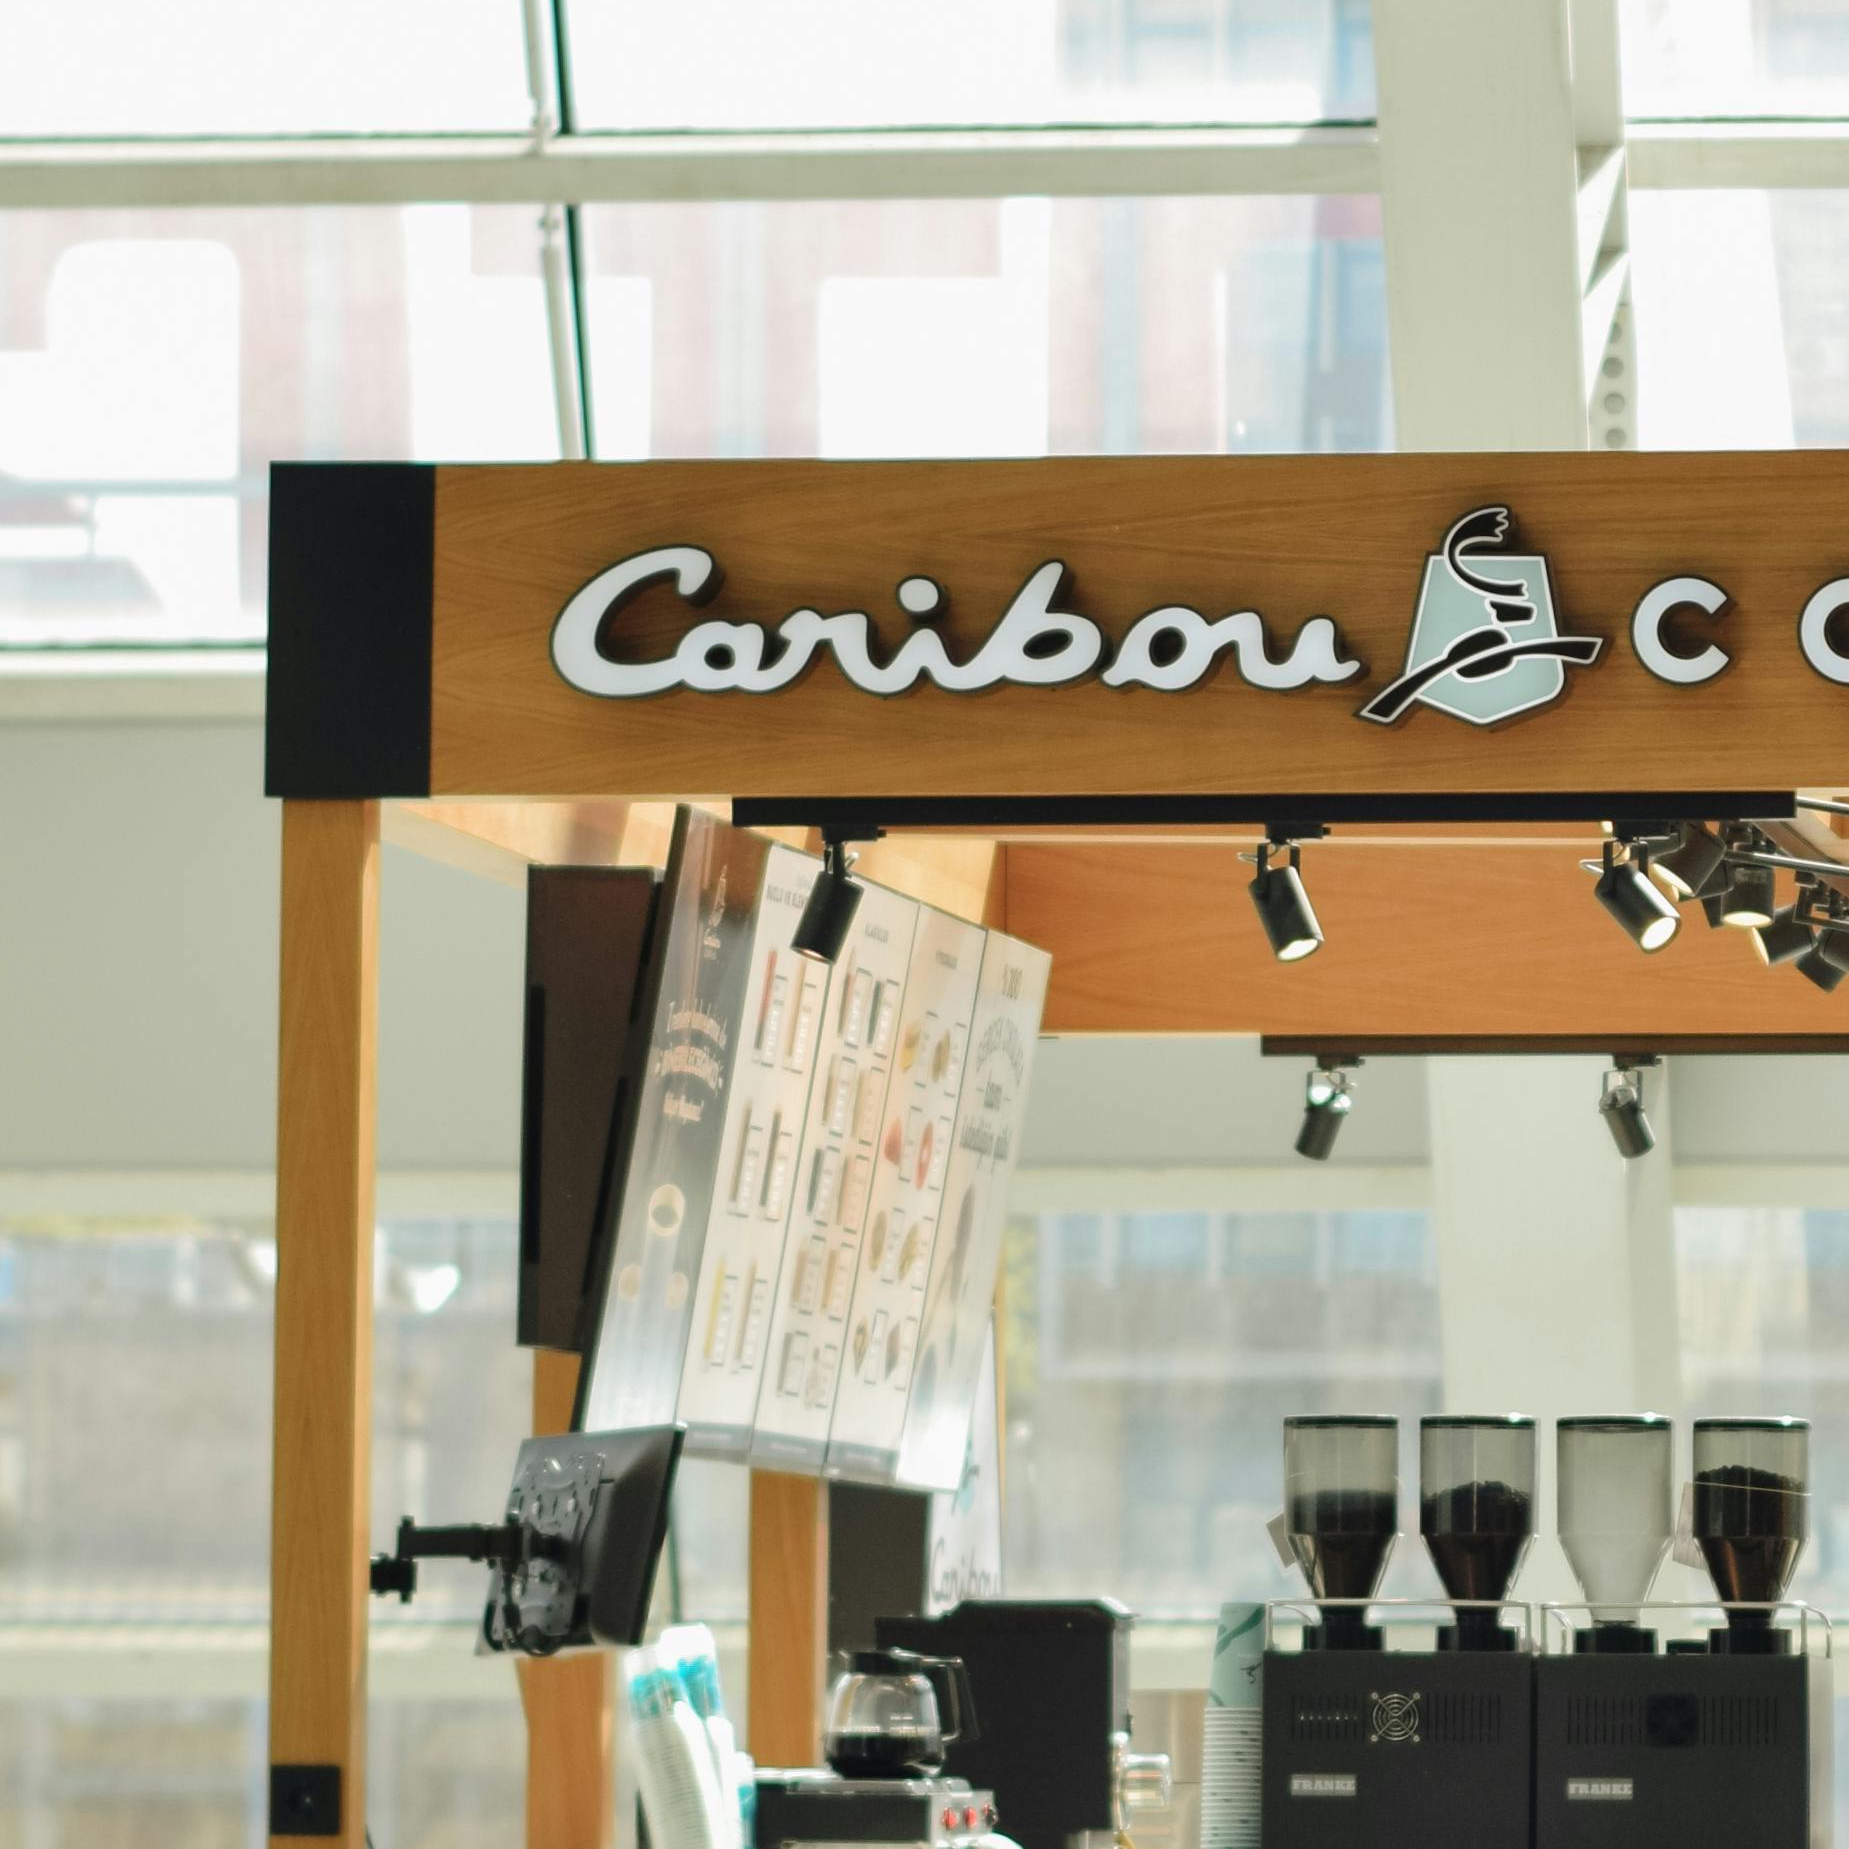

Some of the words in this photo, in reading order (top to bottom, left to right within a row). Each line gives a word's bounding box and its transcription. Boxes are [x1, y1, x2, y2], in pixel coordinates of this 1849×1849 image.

[550, 543, 1366, 698] Caribou
[1292, 1780, 1356, 1792] FRANKE
[1568, 1784, 1632, 1795] FRANKE
